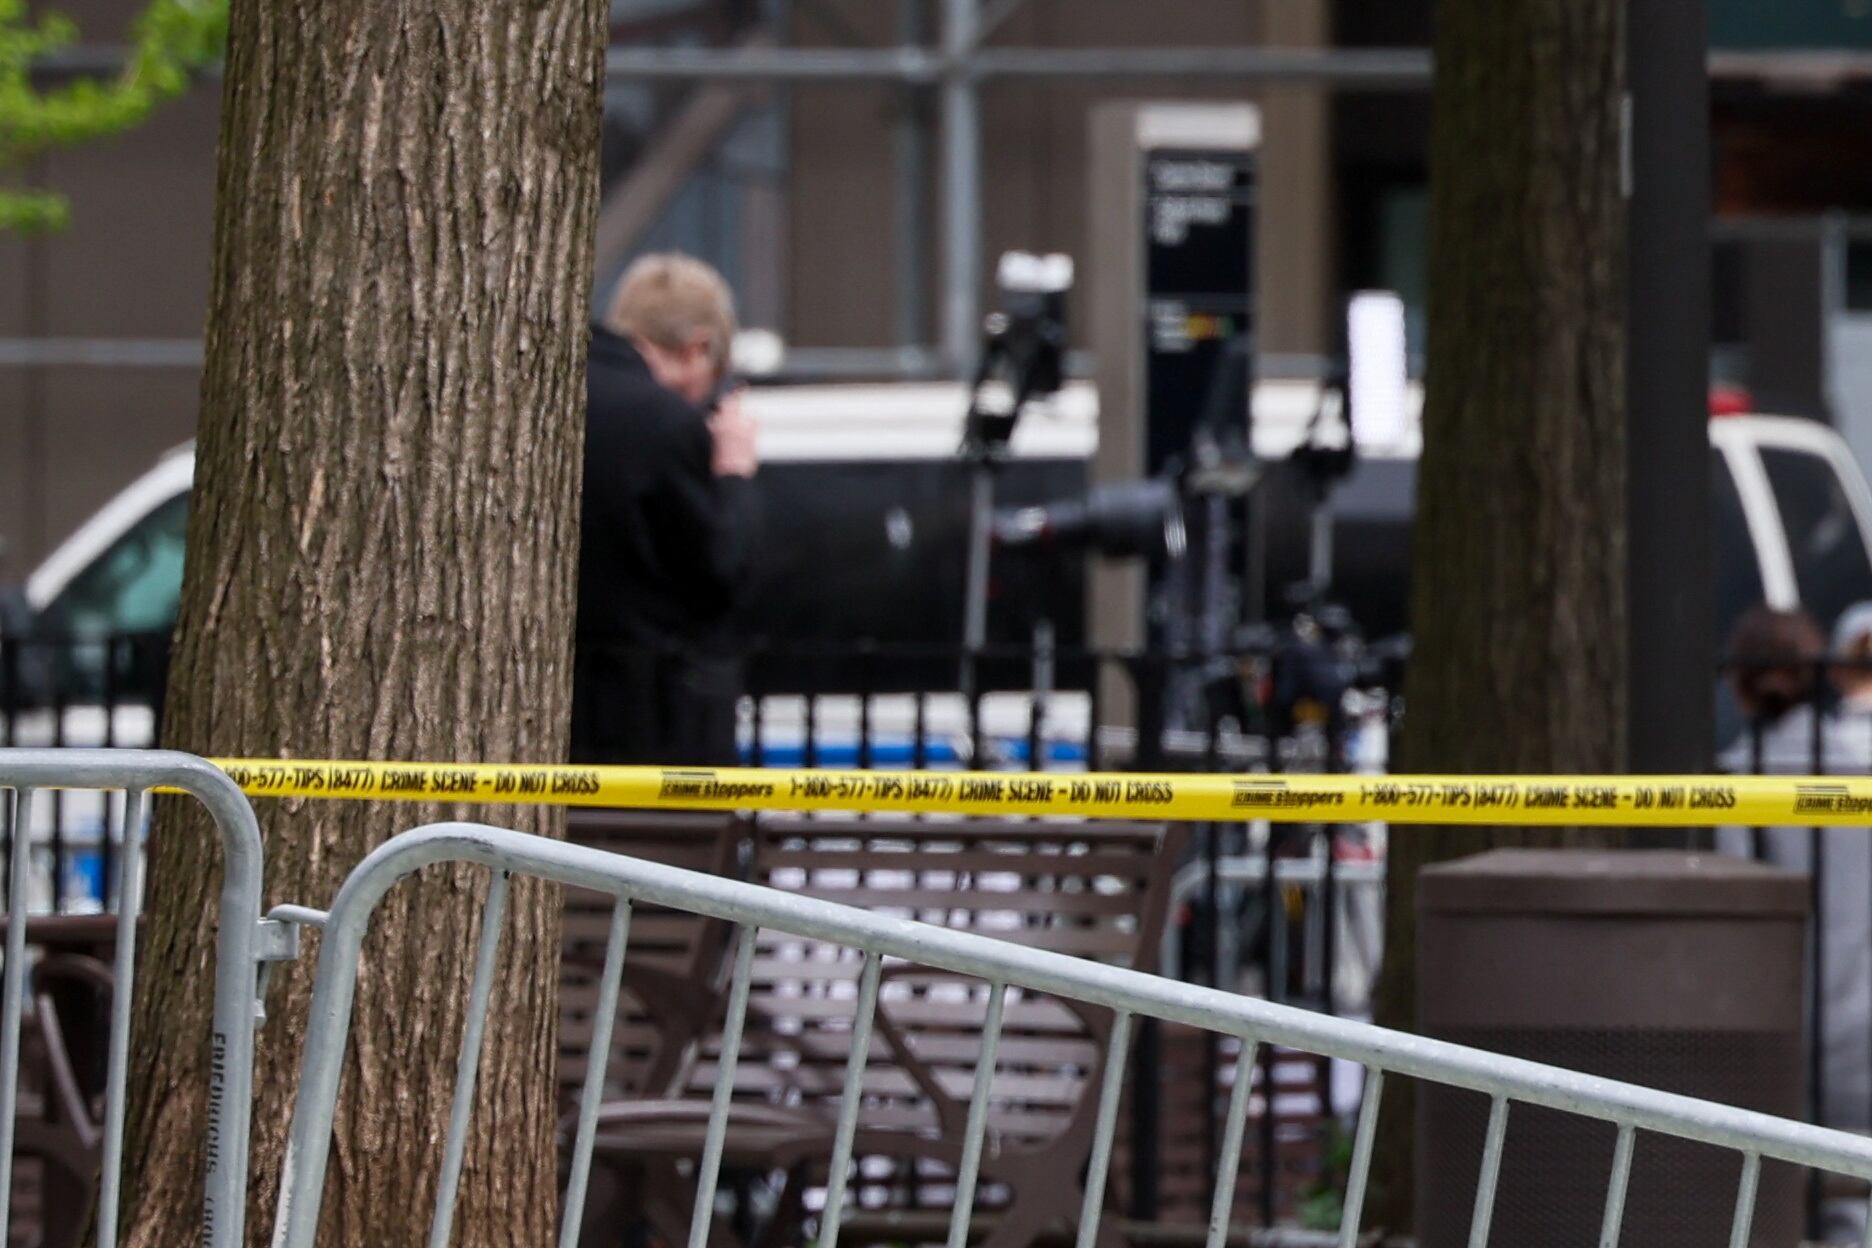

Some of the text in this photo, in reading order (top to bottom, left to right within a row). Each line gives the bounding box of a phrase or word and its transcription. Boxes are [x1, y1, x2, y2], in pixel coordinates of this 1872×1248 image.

[226, 767, 324, 789] 00-577-TIPS
[328, 767, 375, 791] (8477)
[381, 771, 427, 792] CRIME
[431, 771, 477, 792] SCENE
[495, 772, 516, 793] DO
[519, 772, 547, 794] NOT
[551, 772, 600, 794] CROSS
[664, 780, 774, 799] CRIME stoppers
[790, 776, 903, 799] 1-800-577-TIPS
[906, 774, 954, 801] (8477)
[959, 778, 1004, 801] CRIME
[1008, 780, 1053, 802] SCENE
[1070, 781, 1091, 803] DO
[1094, 781, 1121, 803] NOT
[1126, 781, 1173, 804] CROSS
[1235, 789, 1344, 808] CRIME stoppers
[1360, 785, 1471, 807] 1-800-577-TIPS
[1473, 783, 1518, 809] (8477)
[1525, 786, 1569, 808] CRIME
[1573, 787, 1617, 809] SCENE
[1634, 787, 1653, 809] DO
[1657, 787, 1685, 809] NOT
[1689, 787, 1736, 809] CROSS
